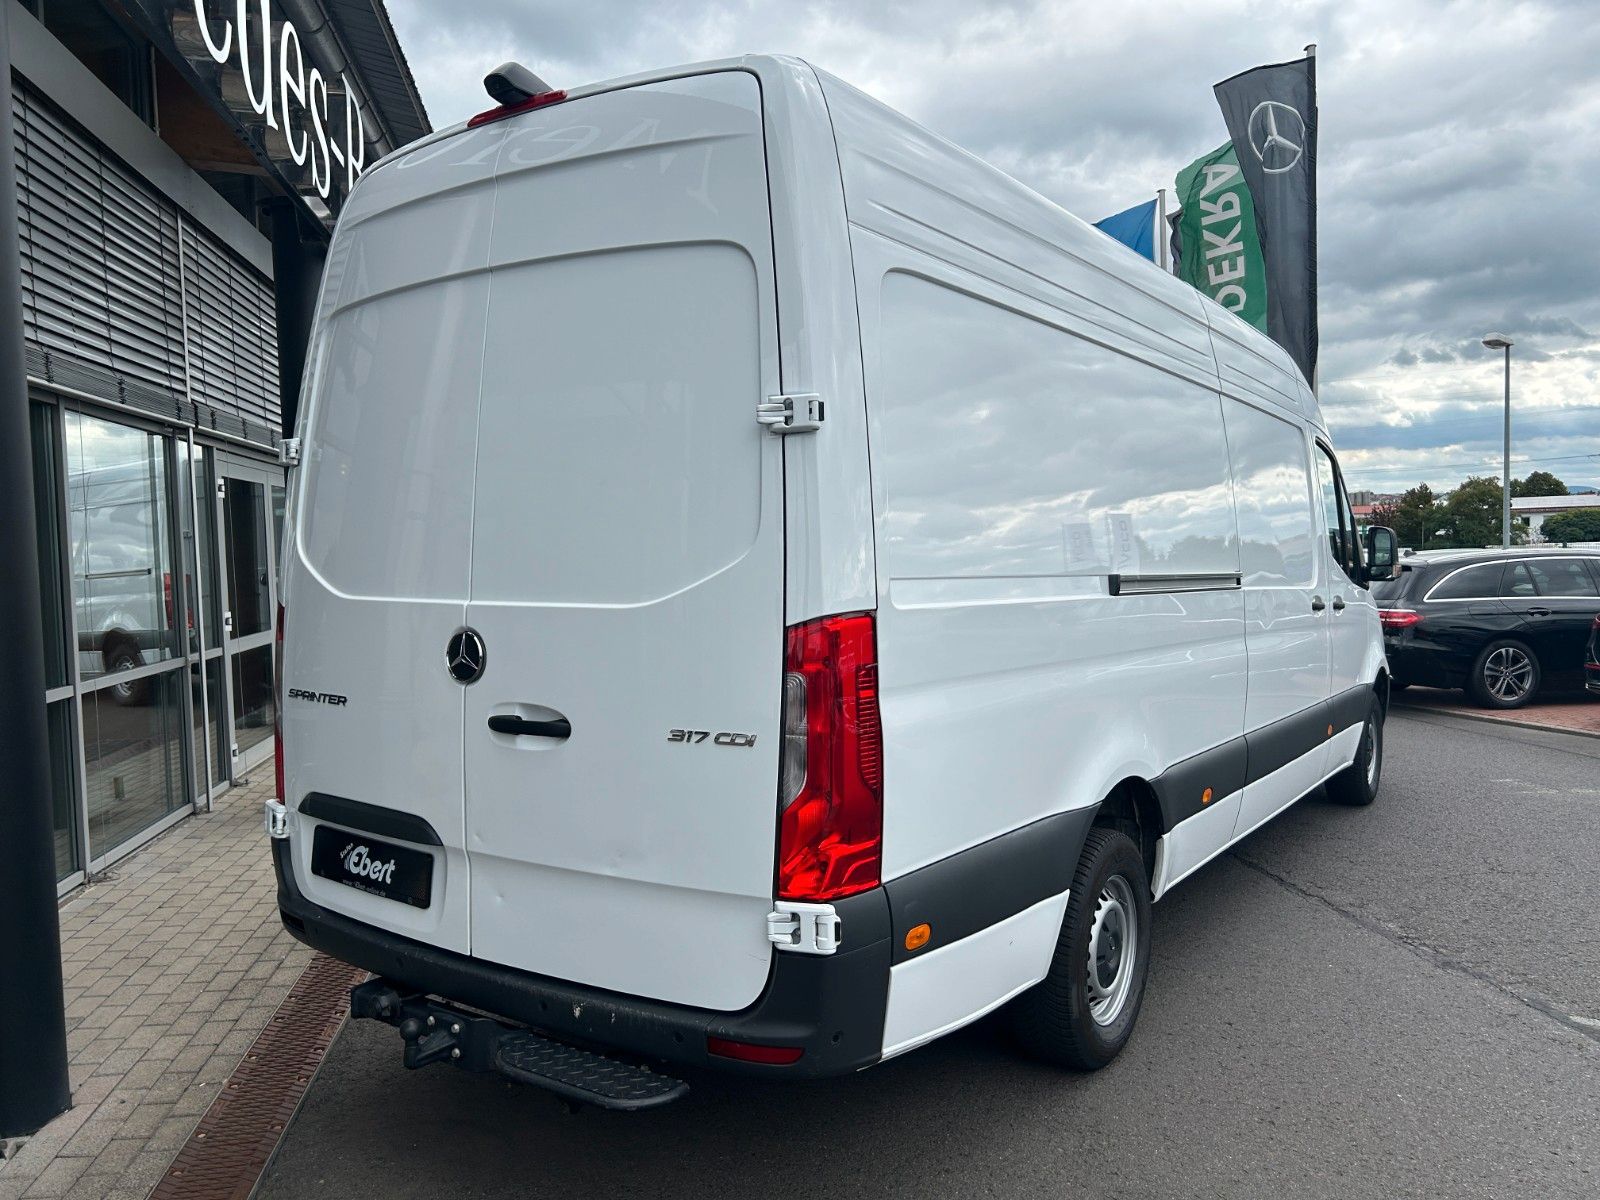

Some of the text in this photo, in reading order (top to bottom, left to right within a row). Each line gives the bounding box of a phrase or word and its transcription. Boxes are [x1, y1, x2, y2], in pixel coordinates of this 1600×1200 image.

[288, 688, 348, 707] SPRINTER
[667, 729, 757, 748] 317 CDI
[350, 845, 396, 885] Ebert
